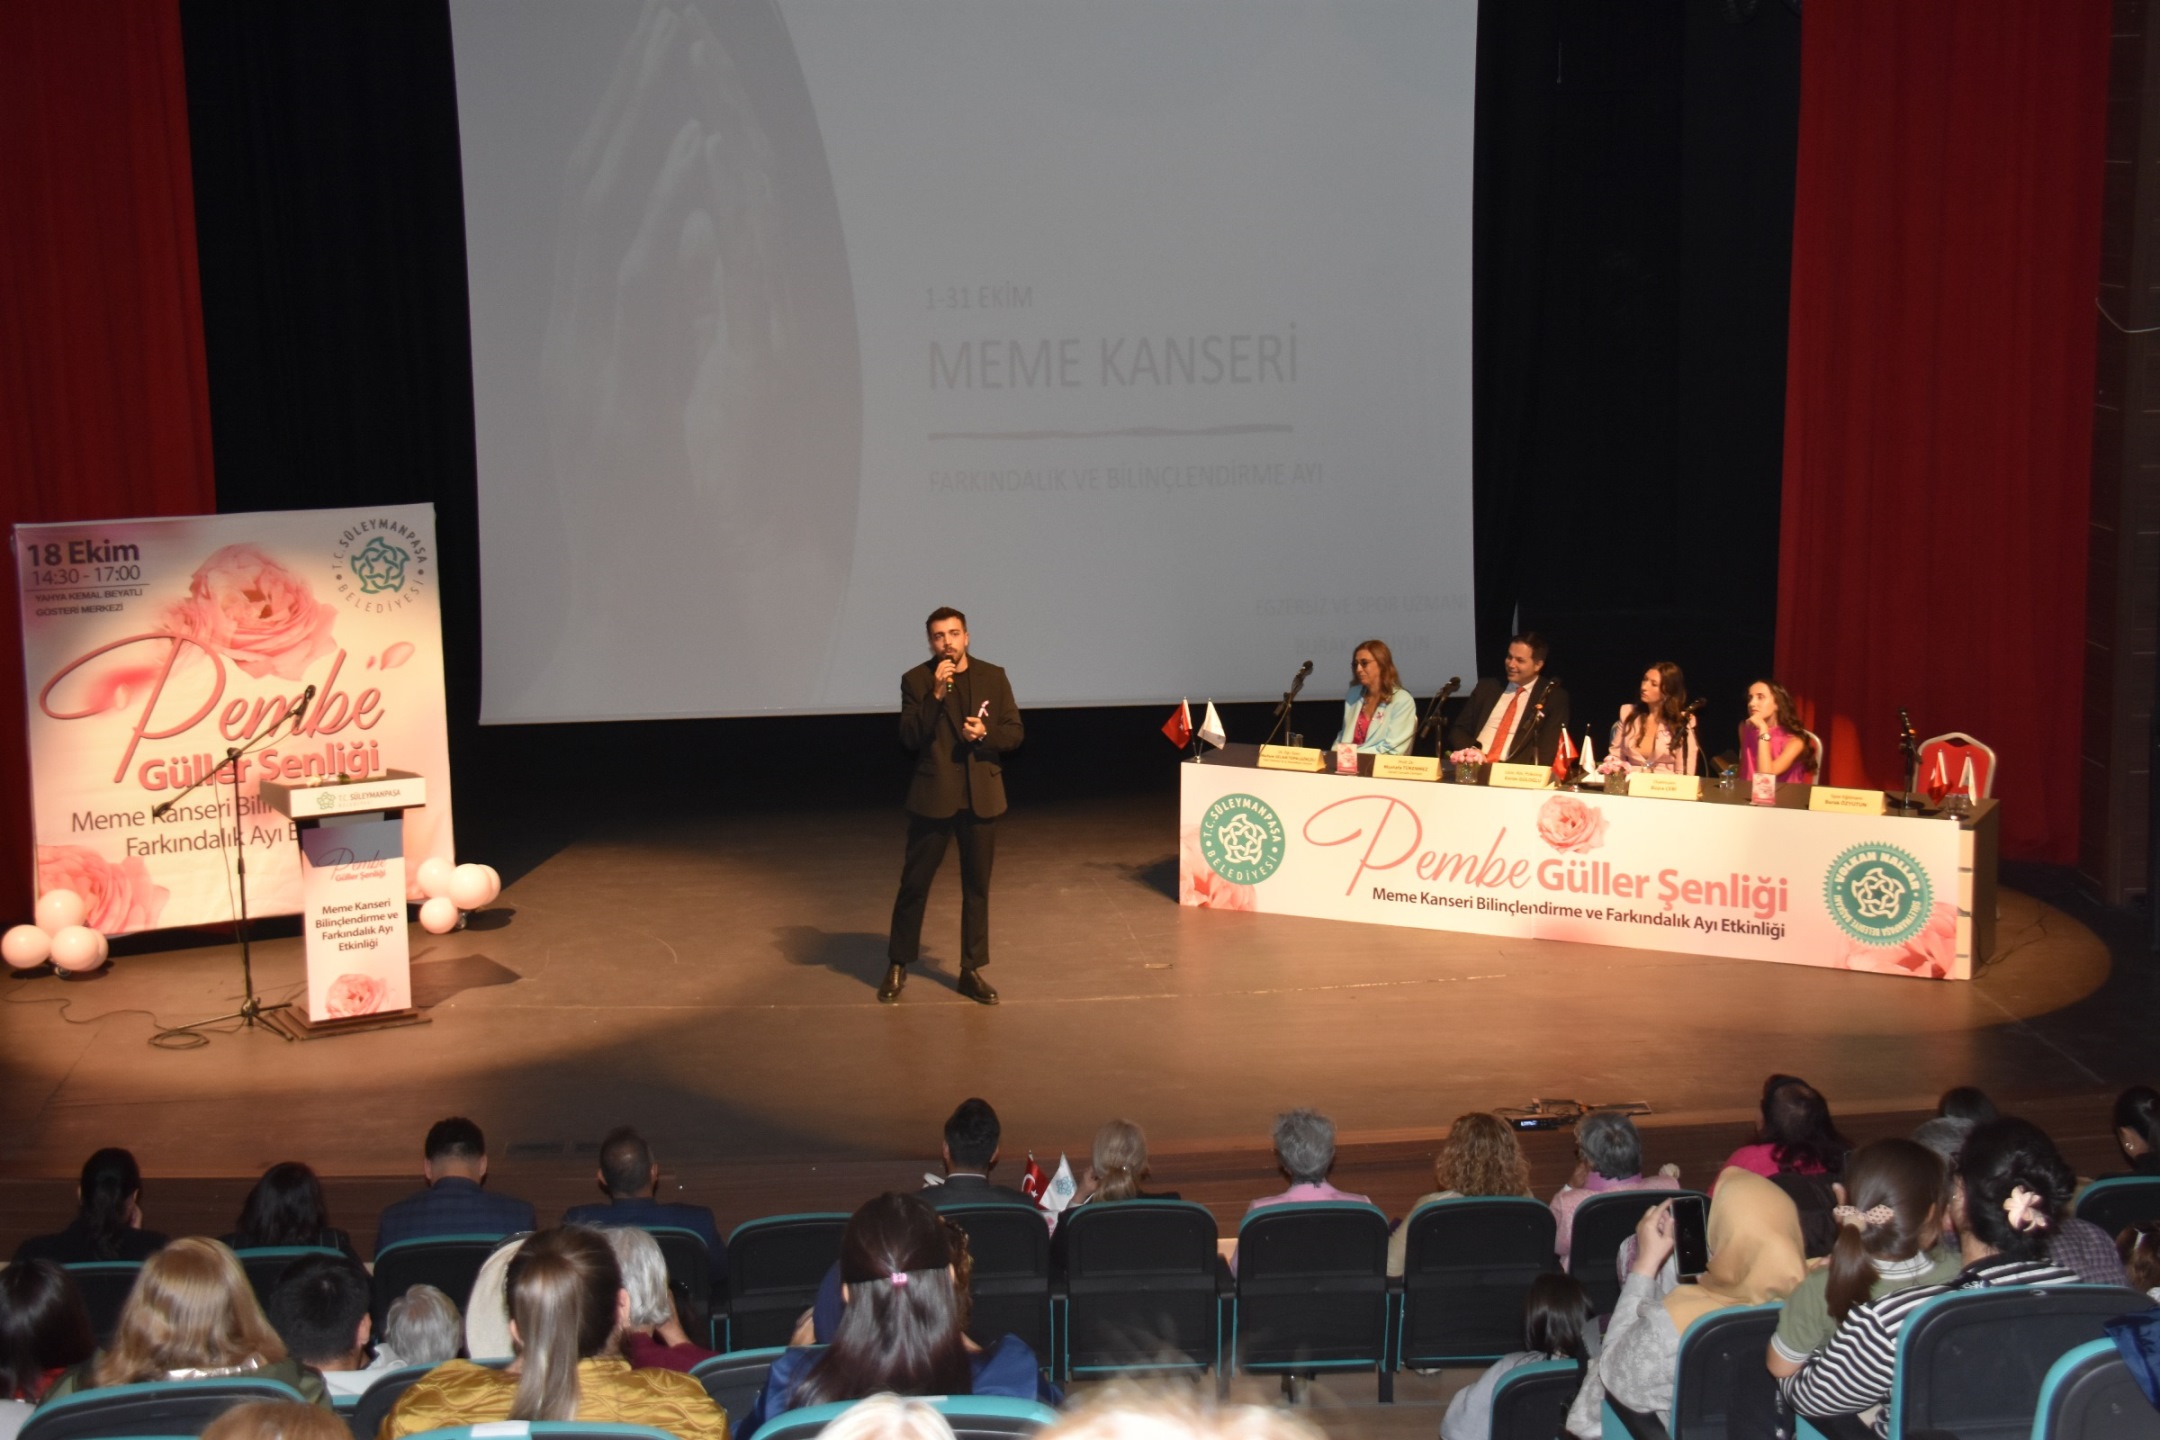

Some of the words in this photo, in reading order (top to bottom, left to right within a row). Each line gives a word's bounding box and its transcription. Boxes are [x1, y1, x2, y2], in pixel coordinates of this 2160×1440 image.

[926, 285, 972, 310] 1-31
[977, 279, 1034, 309] EKİM
[928, 338, 1082, 391] MEME
[1099, 321, 1299, 388] KANSERİ
[928, 468, 1068, 493] FARKINDALIK
[1072, 467, 1100, 491] VE
[1106, 459, 1286, 494] BİLİNÇLENDİRME
[27, 543, 62, 567] 18
[68, 539, 140, 565] Ekim
[339, 518, 427, 563] SÜLEYMANPAŞA
[32, 568, 80, 586] 14:30
[95, 565, 141, 582] 17:00
[35, 591, 66, 602] YAHYA
[68, 590, 101, 600] KEMAL
[35, 606, 79, 617] GÖSTERİ
[81, 603, 123, 613] MERKEZİ
[39, 632, 385, 784] Pembe
[137, 753, 251, 791] Güller
[72, 808, 145, 832] Meme
[151, 798, 231, 824] Kanseri
[1210, 797, 1282, 842] SÜLEYMANPAŞA
[126, 826, 244, 856] Farkındalık
[250, 825, 282, 850] Ayı
[316, 847, 386, 880] Pembe
[1207, 850, 1278, 881] BELEDİYESİ
[1303, 794, 1531, 896] Pembe
[1536, 858, 1650, 899] Güller
[1657, 868, 1789, 920] Şenliği
[1834, 851, 1877, 883] VOLKAN
[315, 912, 386, 928] Bilinçlendirme
[387, 912, 399, 920] ve
[322, 904, 353, 915] Meme
[354, 898, 391, 910] Kanseri
[1372, 887, 1418, 903] Meme
[1420, 892, 1473, 909] Kanseri
[1476, 897, 1583, 918] Bilinçlendirme
[1586, 909, 1603, 920] ve
[1606, 908, 1691, 929] Farkındalık
[1693, 916, 1718, 933] Ayı
[1721, 918, 1786, 940] Etkinliği
[322, 927, 376, 940] Farkındalık
[378, 925, 394, 936] Ayı
[338, 938, 379, 951] Etkinliği
